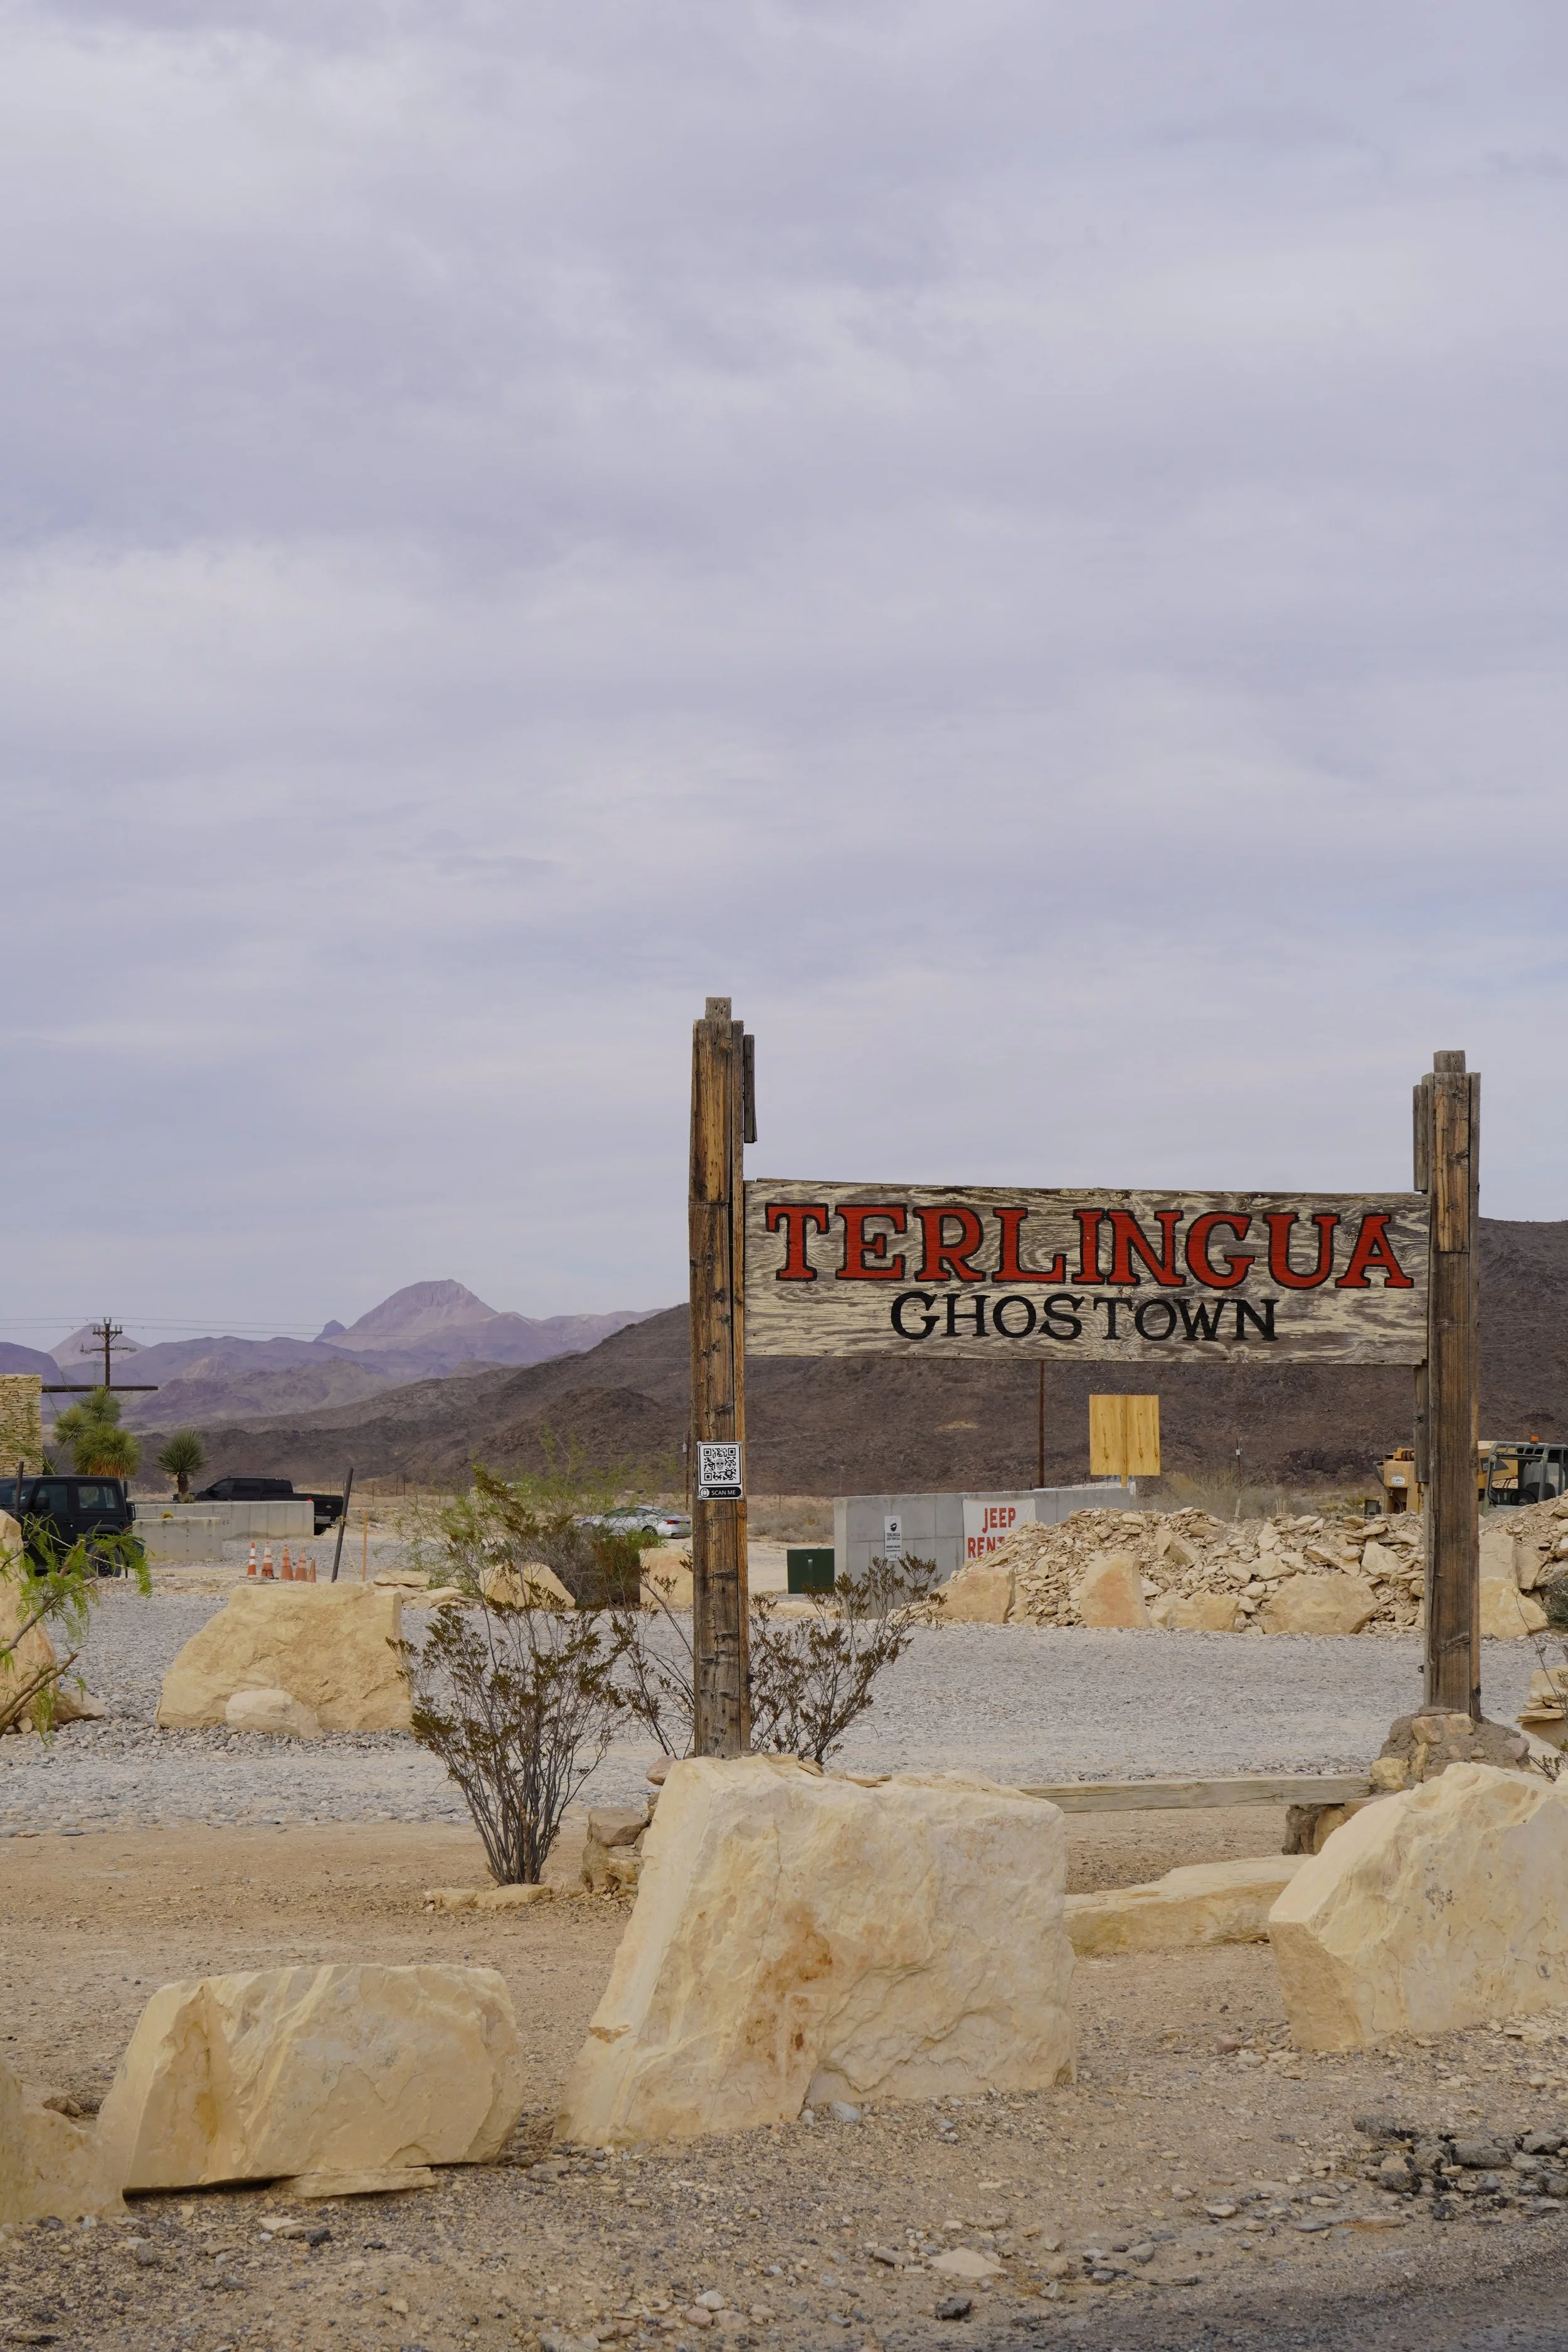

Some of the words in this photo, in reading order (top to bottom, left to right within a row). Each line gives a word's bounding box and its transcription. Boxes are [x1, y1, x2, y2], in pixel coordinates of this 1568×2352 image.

[765, 1202, 1414, 1290] TERLINGUA
[891, 1291, 1280, 1342] GHOSTOWN
[982, 1507, 1016, 1534] JEEP
